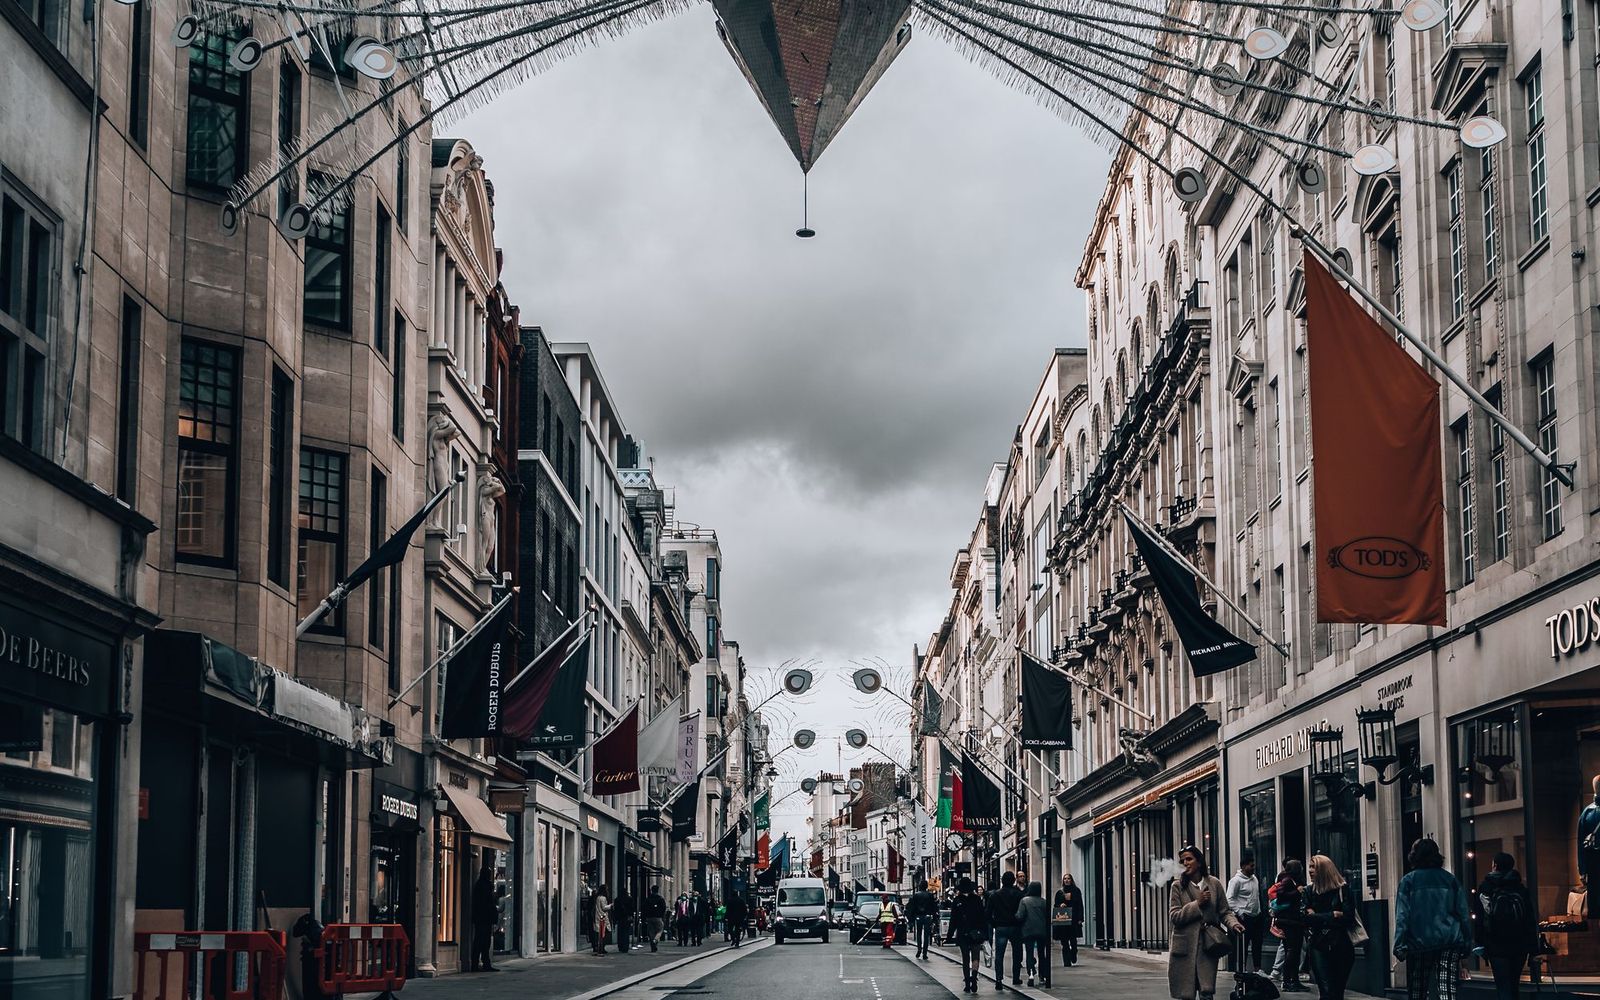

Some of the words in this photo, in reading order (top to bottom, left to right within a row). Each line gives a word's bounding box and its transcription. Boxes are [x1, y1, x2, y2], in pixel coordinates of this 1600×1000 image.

[1354, 549, 1408, 568] TOD'S
[1546, 597, 1600, 658] TOD'S
[28, 637, 90, 687] BEERS
[490, 642, 501, 688] DUBUIS
[1190, 644, 1221, 656] RICHARD
[1377, 674, 1413, 701] STANDBROOK
[487, 689, 499, 731] ROGER
[685, 724, 695, 770] BRUN
[1256, 734, 1294, 771] RICHARD
[595, 769, 636, 783] Cartier
[639, 766, 677, 776] ALENTINO
[965, 816, 999, 826] DAMIANI
